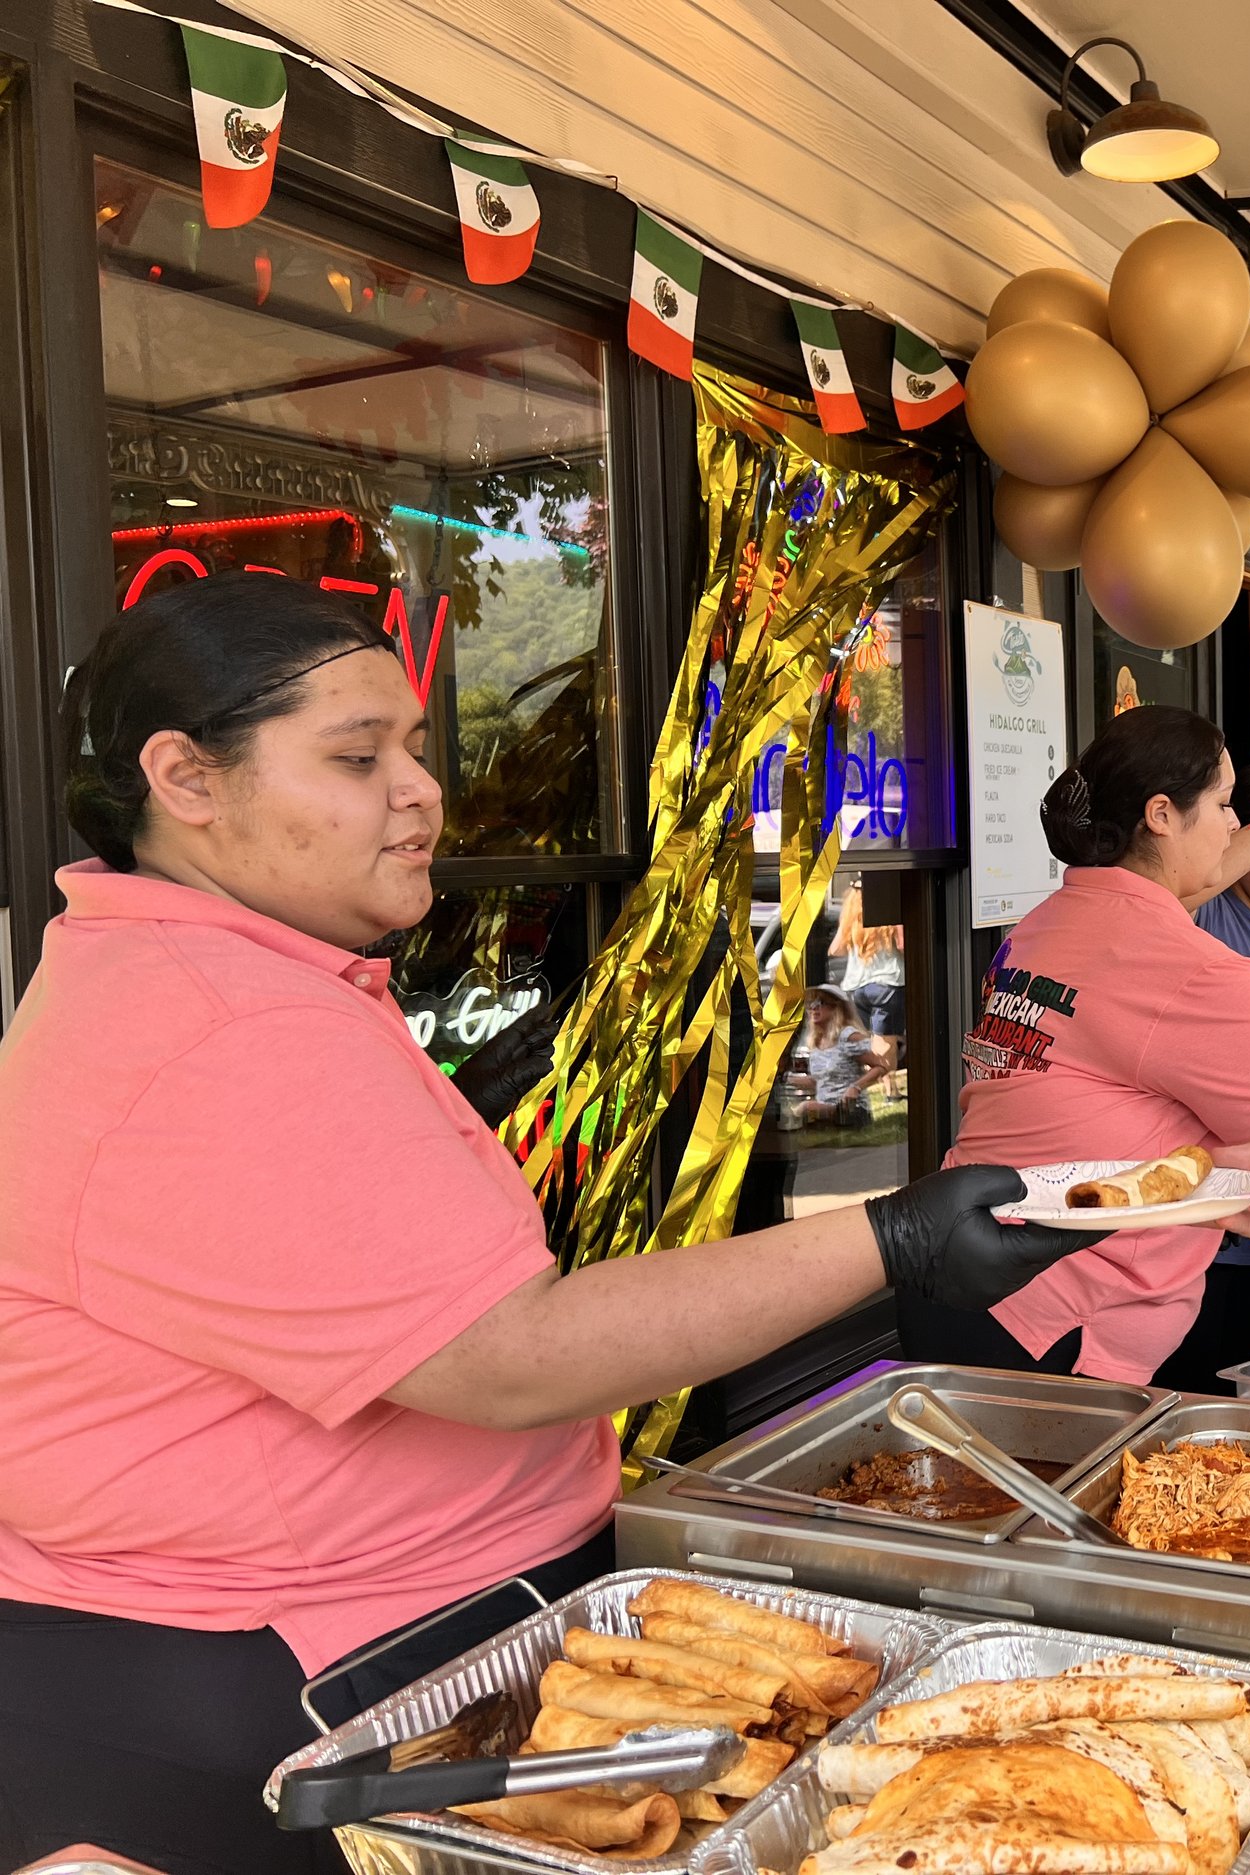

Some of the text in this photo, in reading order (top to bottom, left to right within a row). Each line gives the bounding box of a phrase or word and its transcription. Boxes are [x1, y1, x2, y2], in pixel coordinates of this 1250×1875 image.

[989, 713, 1046, 734] HIDALGO GRILL
[1027, 975, 1079, 1018] GRILL
